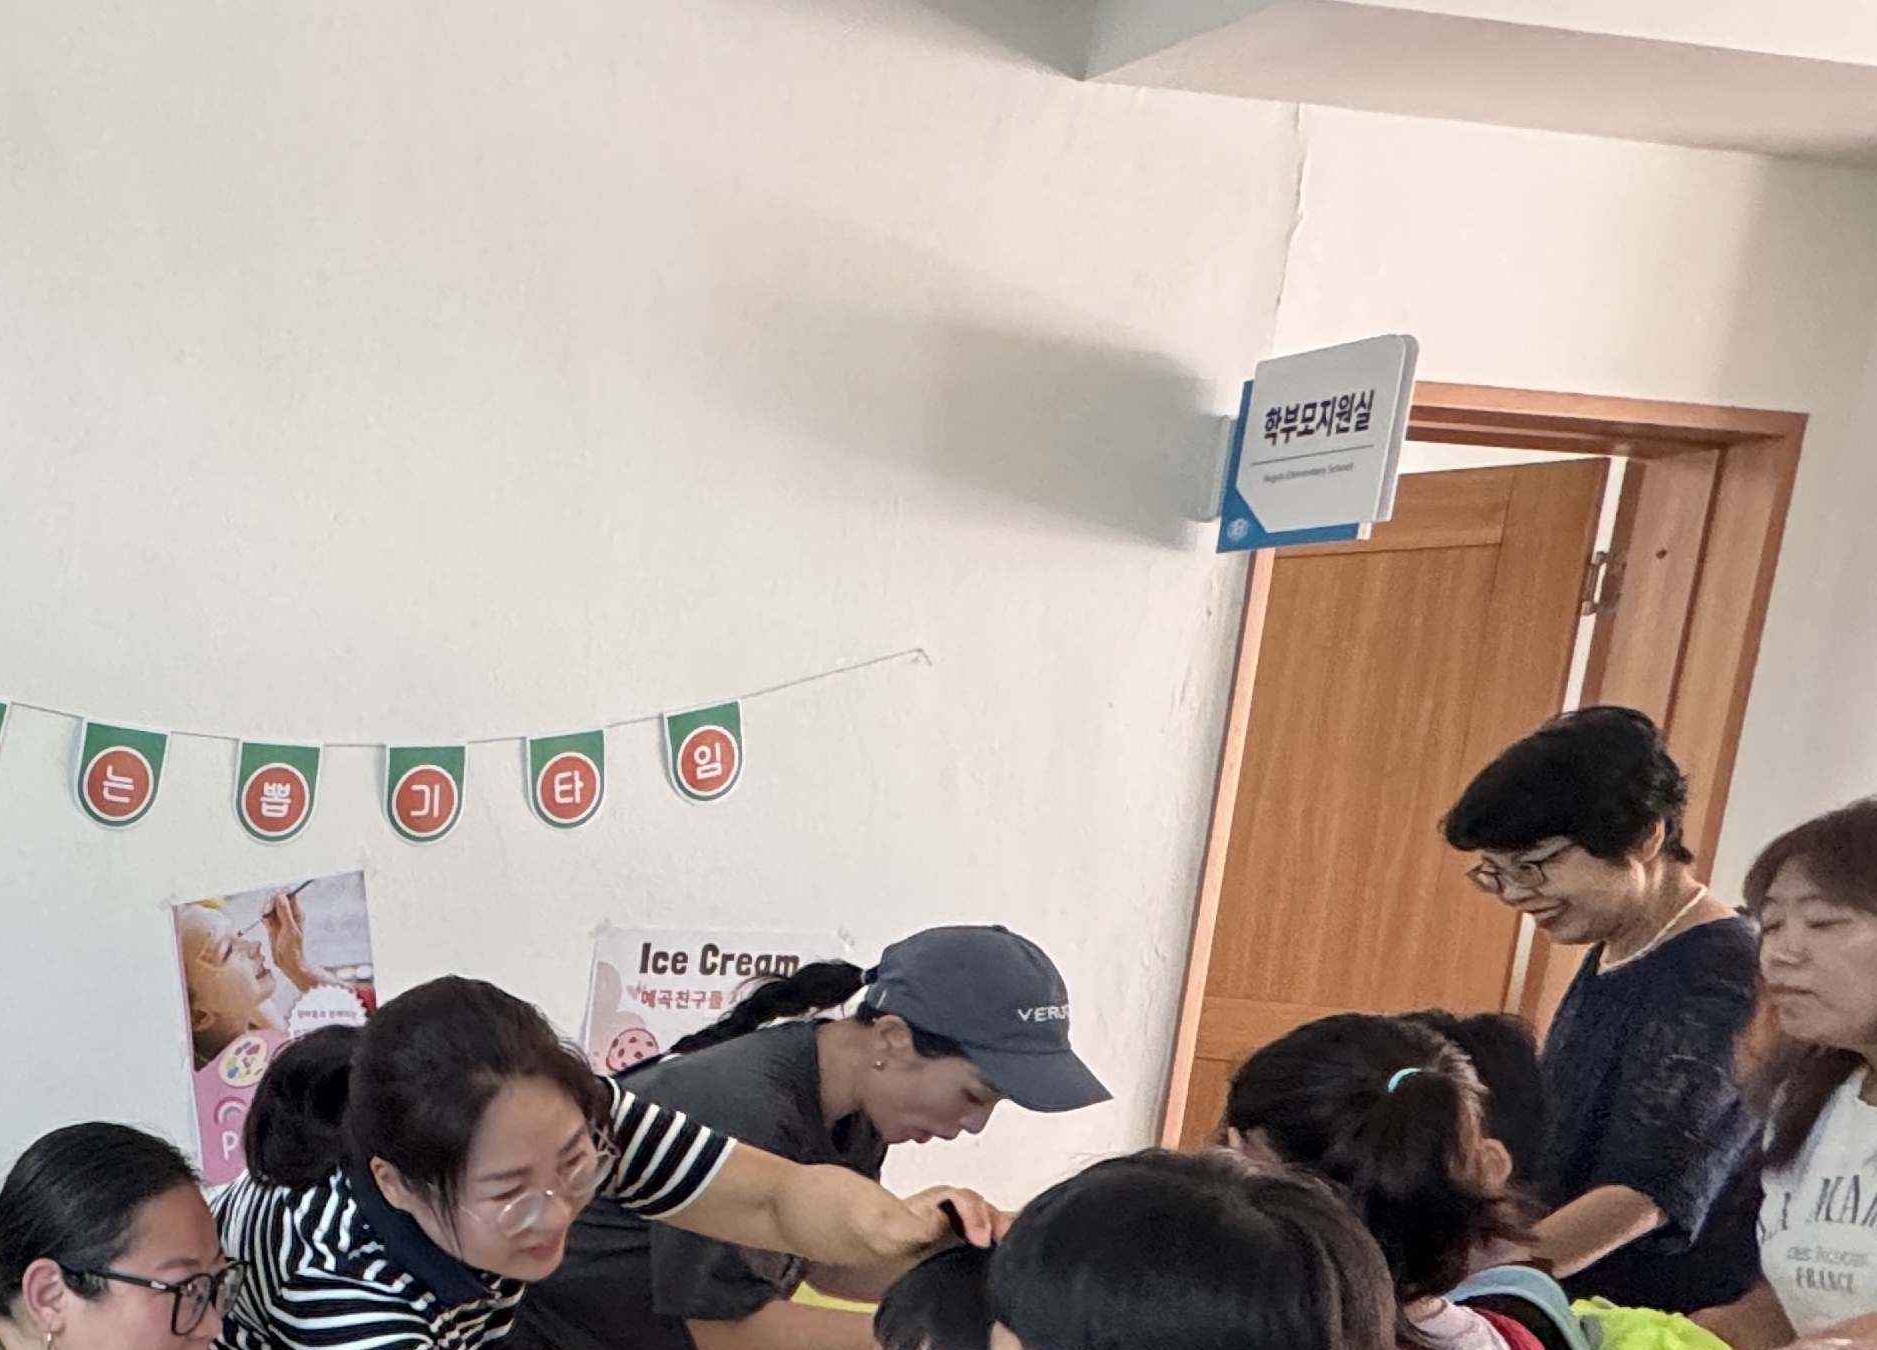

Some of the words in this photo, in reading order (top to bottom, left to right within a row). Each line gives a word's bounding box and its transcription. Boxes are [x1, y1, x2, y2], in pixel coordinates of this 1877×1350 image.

[1264, 389, 1375, 445] 학부모지원실
[638, 942, 689, 975] Ice
[698, 943, 801, 978] Cream
